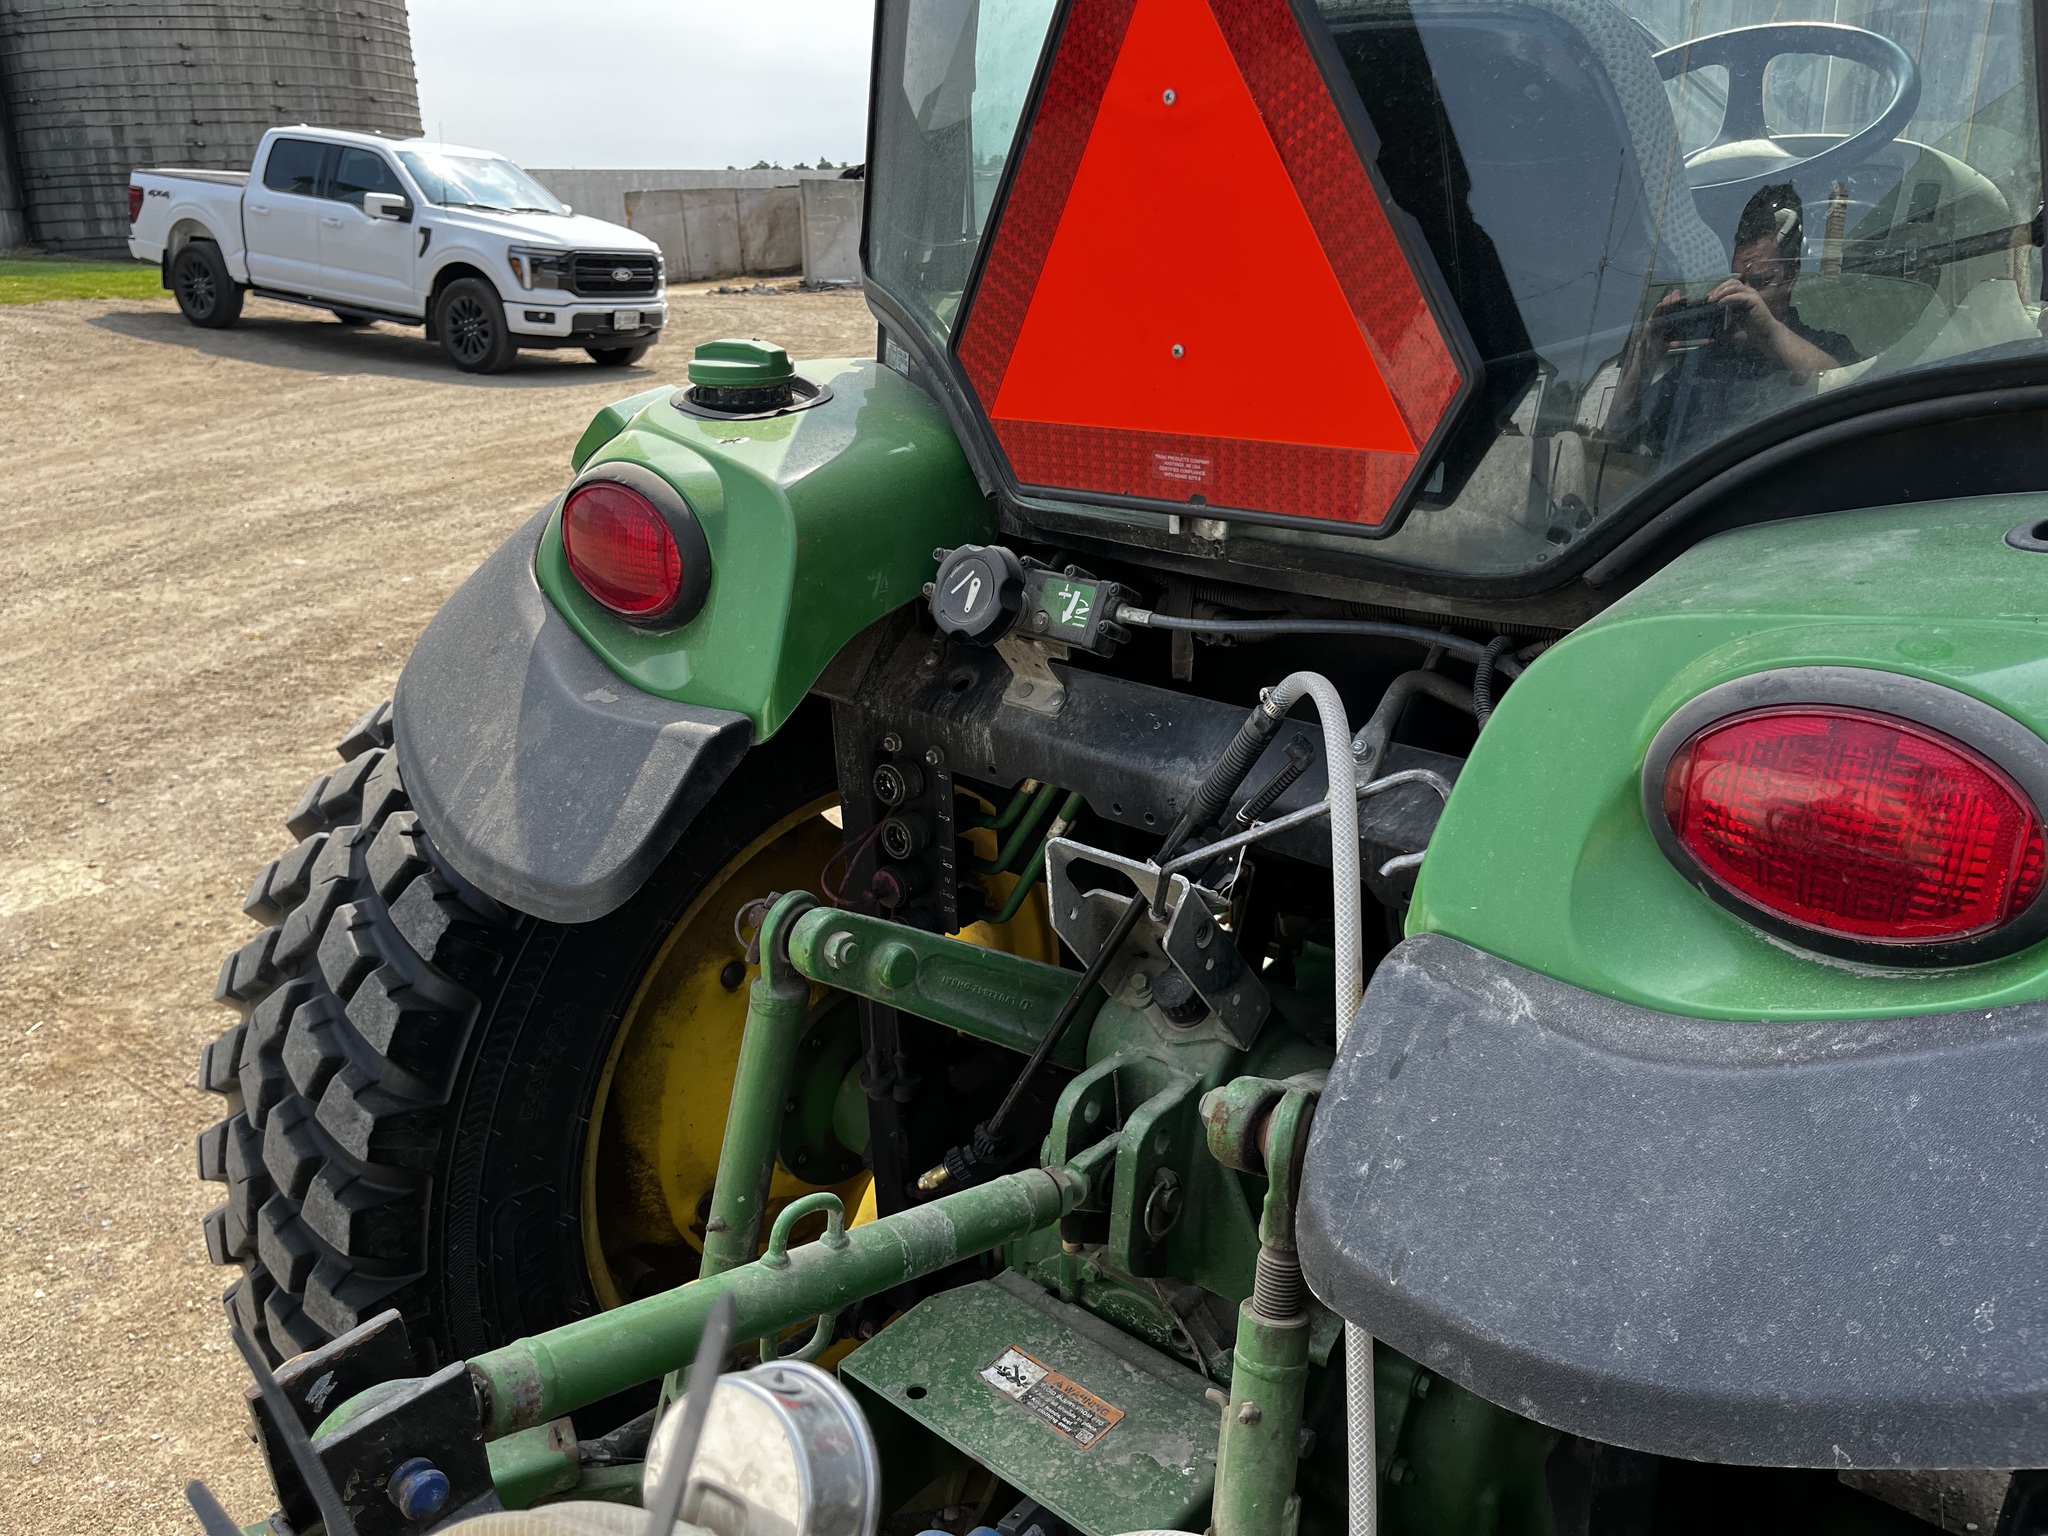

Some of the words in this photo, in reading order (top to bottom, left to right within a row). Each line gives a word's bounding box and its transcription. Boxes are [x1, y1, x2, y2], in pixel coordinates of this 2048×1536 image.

[1180, 468, 1205, 476] COMPLIANCE
[1055, 1393, 1076, 1408] INJURY
[1063, 1385, 1110, 1416] WARNING
[1036, 1407, 1059, 1424] clothing
[1061, 1416, 1073, 1426] feet
